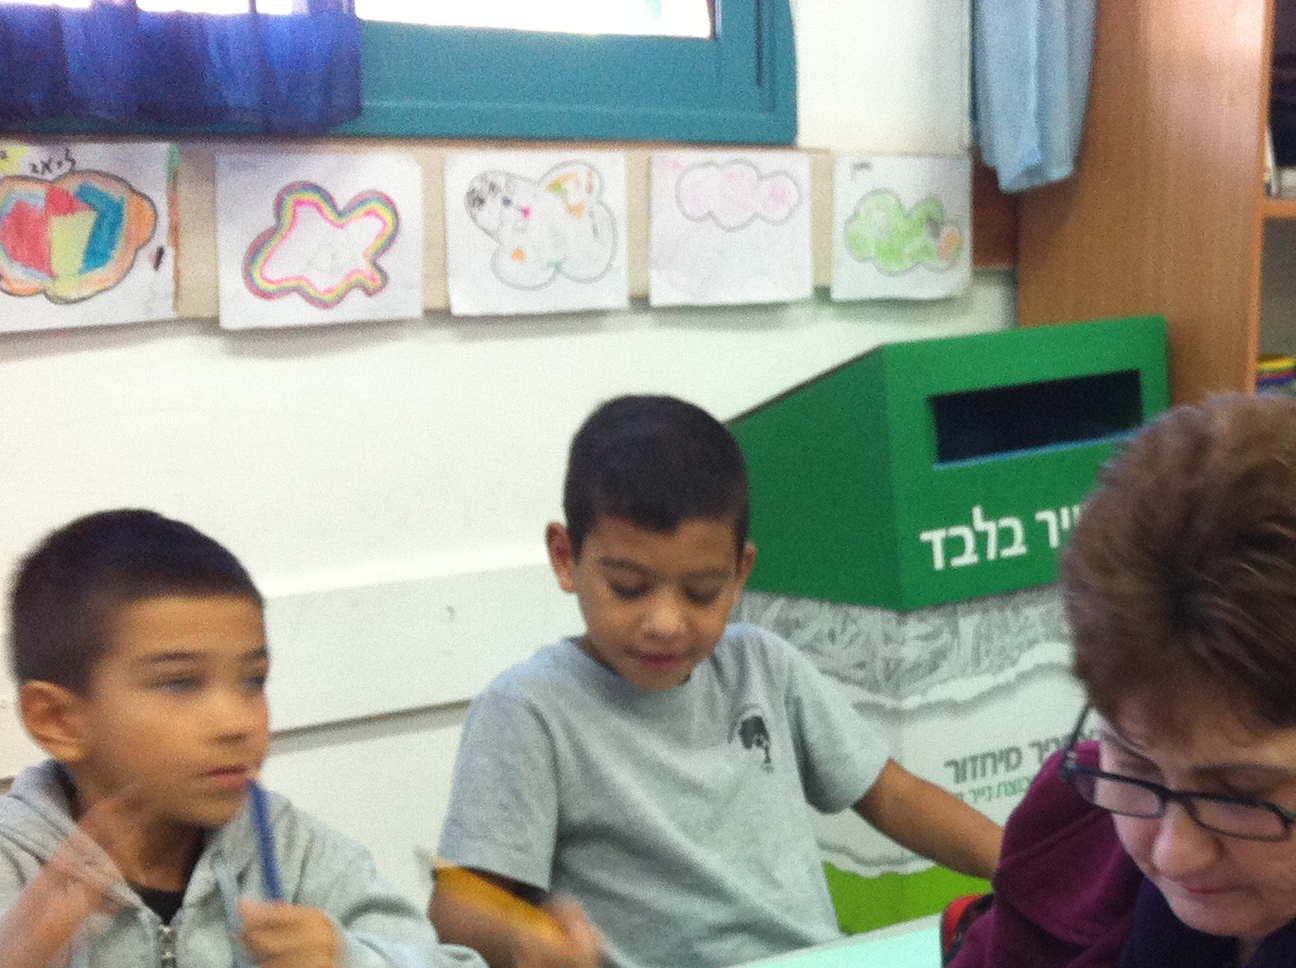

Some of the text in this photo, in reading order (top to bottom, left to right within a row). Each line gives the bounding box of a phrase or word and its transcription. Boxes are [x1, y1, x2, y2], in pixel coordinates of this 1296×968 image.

[919, 504, 1082, 571] ייר בלבד
[944, 746, 1023, 784] מיחזור
